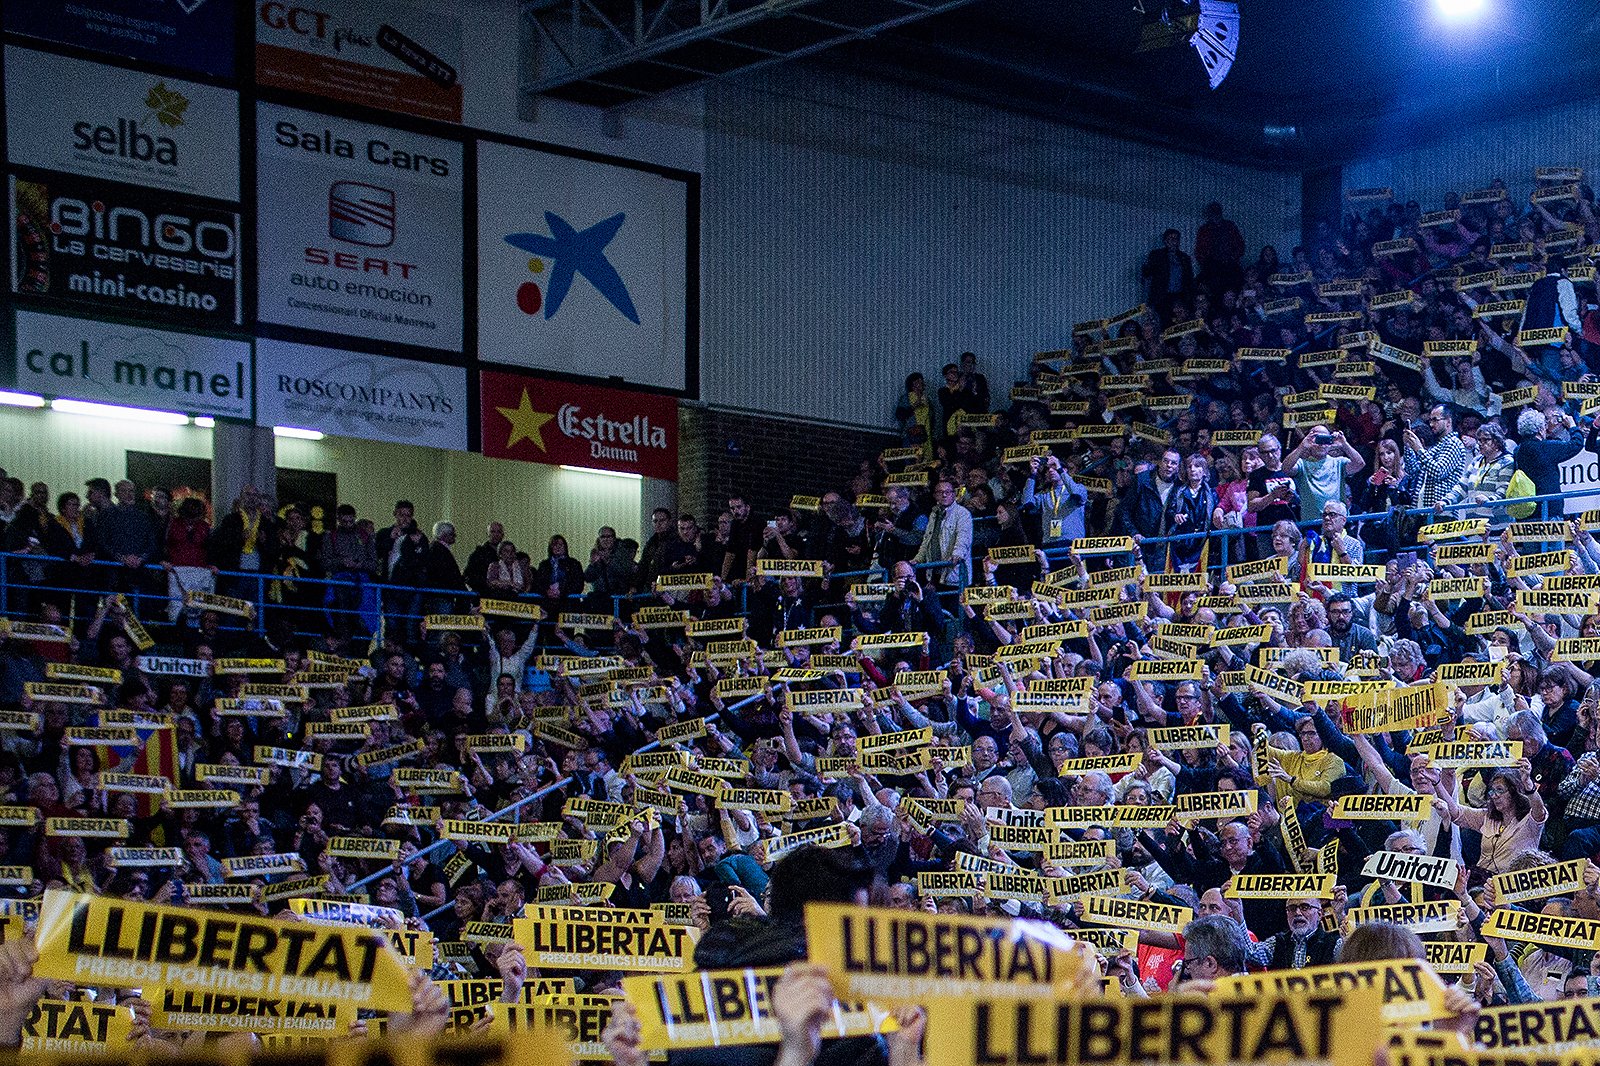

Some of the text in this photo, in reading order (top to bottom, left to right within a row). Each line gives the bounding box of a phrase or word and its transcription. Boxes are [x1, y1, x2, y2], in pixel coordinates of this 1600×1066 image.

[260, 2, 331, 38] GCT
[73, 118, 179, 167] selba
[275, 121, 450, 177] Sala Cars
[53, 237, 85, 256] La
[305, 246, 418, 279] SEAT
[68, 271, 218, 312] mini-casino
[290, 271, 432, 308] auto emoción
[26, 340, 244, 399] cal manel
[277, 374, 453, 414] ROSCOMPANYS
[556, 401, 667, 450] Estrella
[590, 440, 639, 463] Damm
[1423, 519, 1485, 535] LLIBERTAT
[1523, 592, 1591, 609] LLIBERTAT
[52, 664, 117, 681] LLIBERTAT
[148, 657, 202, 675] Unitat!
[790, 689, 857, 708] LLIBERTAT
[862, 728, 926, 748] LLIBERTAT
[1433, 743, 1513, 761] LLIBERTAT
[668, 768, 719, 790] LLIBERTAT
[1177, 790, 1248, 813] LLIBERTAT
[1342, 795, 1424, 812] LLIBERTAT
[229, 856, 293, 871] LLIBERTAT
[1377, 853, 1445, 884] Unitat!
[1052, 870, 1120, 895] LLIBERTAT
[1235, 875, 1326, 892] LLIBERTAT
[1497, 861, 1579, 893] LLIBERTAT
[1088, 898, 1183, 924] LLIBERTAT
[67, 901, 387, 984] LLIBERTAT
[534, 922, 686, 957] LLIBERTAT
[841, 916, 1055, 983] LLIBERTAT
[540, 954, 581, 964] PRESOS
[584, 952, 630, 966] POLÍTICS
[638, 957, 683, 968] EXILIATS!
[1426, 943, 1476, 964] ERTAT
[168, 1014, 216, 1027] PRESOS
